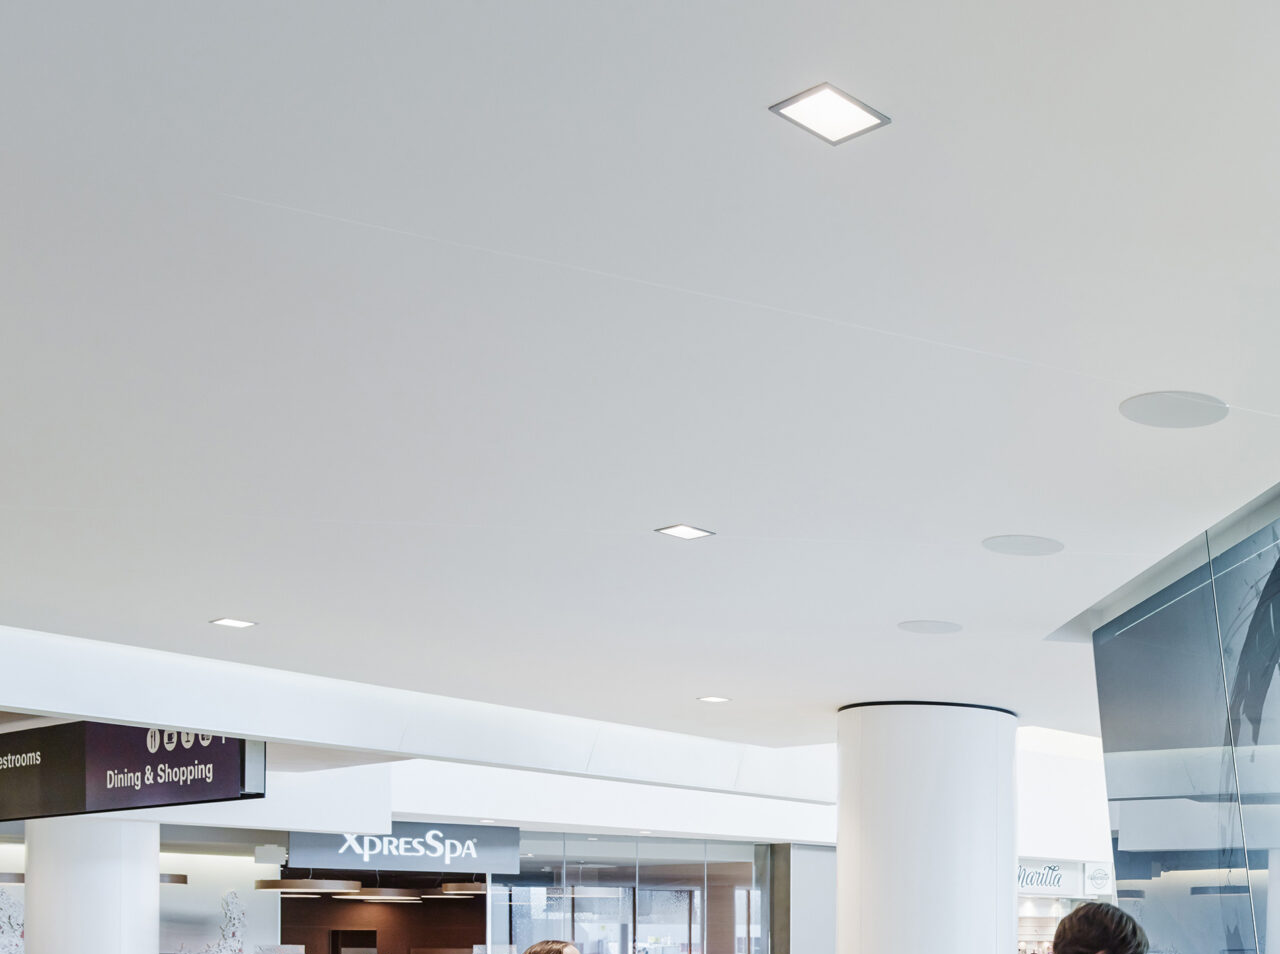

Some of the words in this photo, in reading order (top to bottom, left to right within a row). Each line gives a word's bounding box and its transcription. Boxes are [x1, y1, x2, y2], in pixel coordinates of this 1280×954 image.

[106, 768, 141, 790] Dining
[144, 765, 154, 784] &
[157, 760, 213, 785] Shopping
